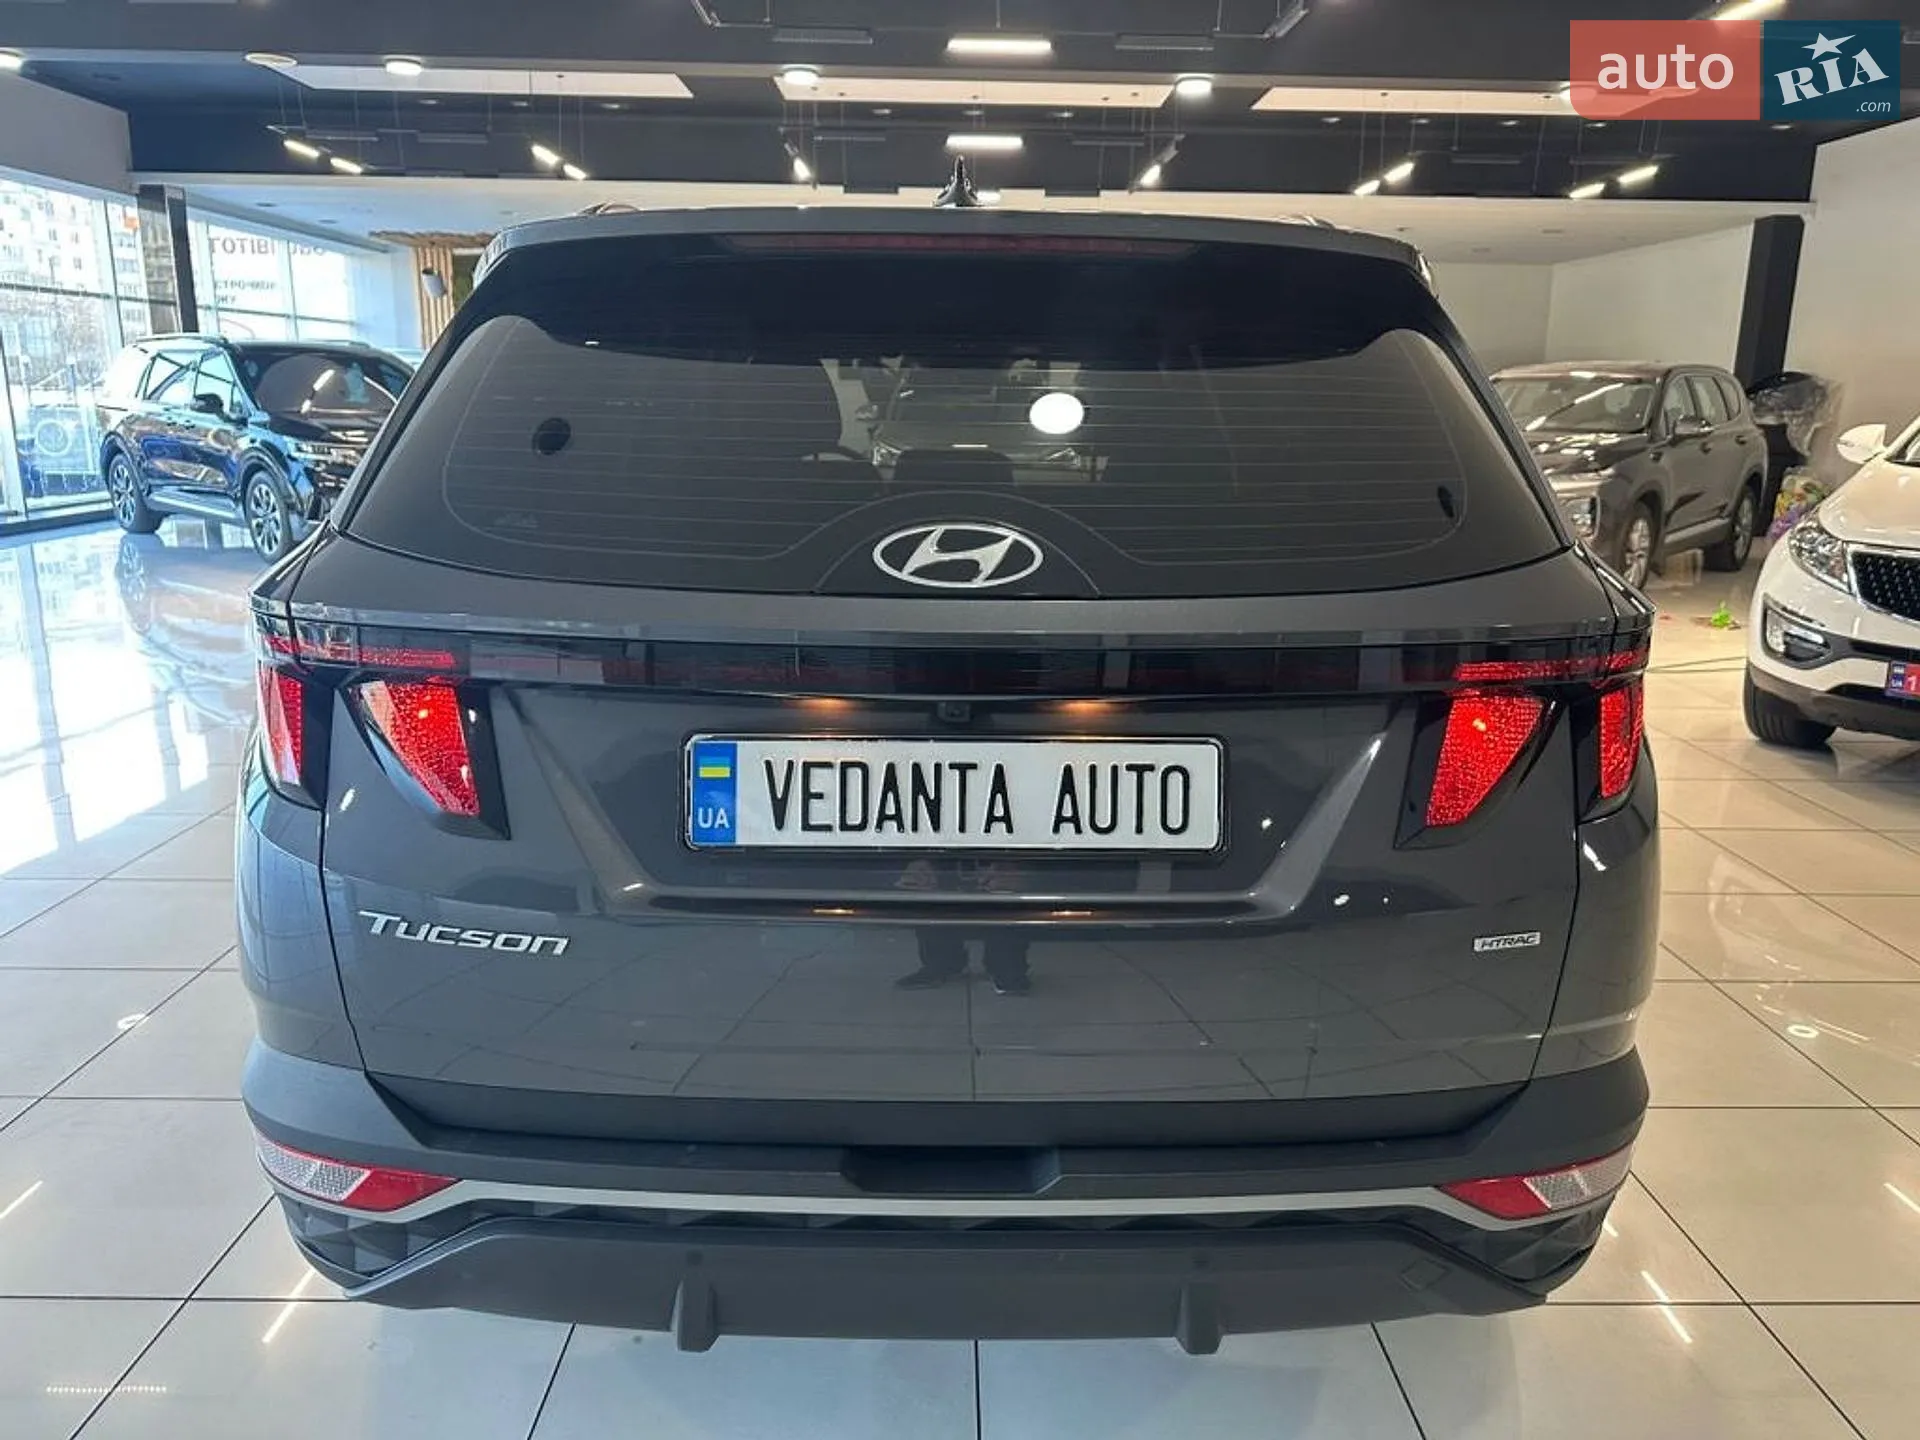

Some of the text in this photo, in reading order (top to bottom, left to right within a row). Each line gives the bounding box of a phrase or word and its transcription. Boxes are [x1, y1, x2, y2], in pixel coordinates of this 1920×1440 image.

[697, 807, 729, 829] UA
[764, 759, 1191, 835] VEDANTA AUTO
